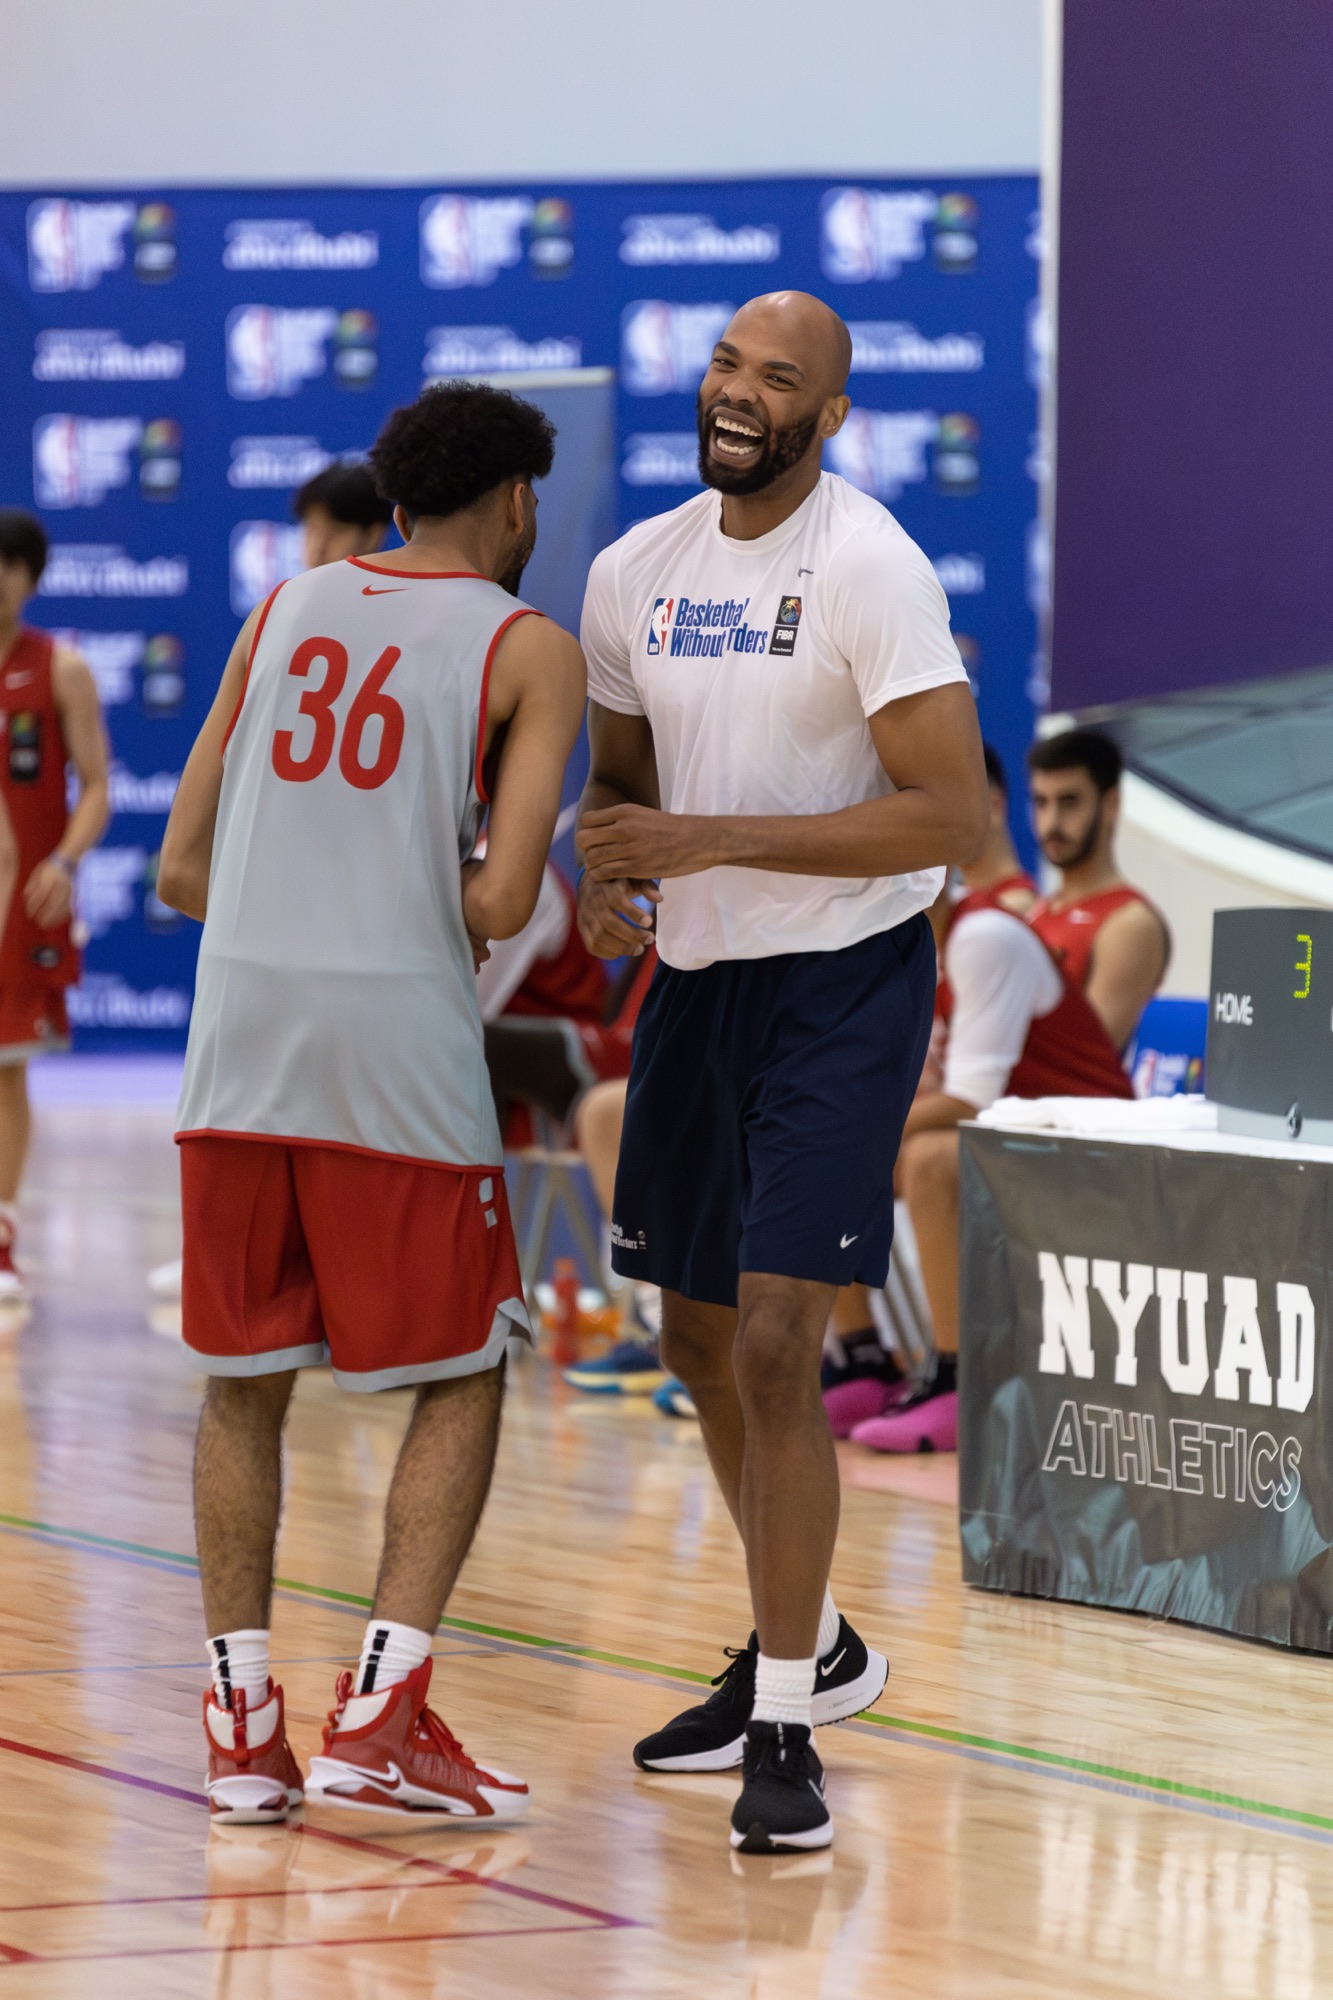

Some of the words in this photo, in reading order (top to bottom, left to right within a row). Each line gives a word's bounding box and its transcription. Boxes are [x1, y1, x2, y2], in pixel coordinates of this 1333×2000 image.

[675, 598, 750, 627] Basketba
[776, 629, 794, 640] FIBA
[670, 628, 726, 657] Without
[727, 622, 768, 655] rders
[271, 636, 405, 790] 36
[1294, 934, 1312, 998] 3
[1215, 992, 1254, 1025] HOME
[1038, 1251, 1315, 1413] NYUAD
[1042, 1400, 1302, 1512] ATHLETICS
